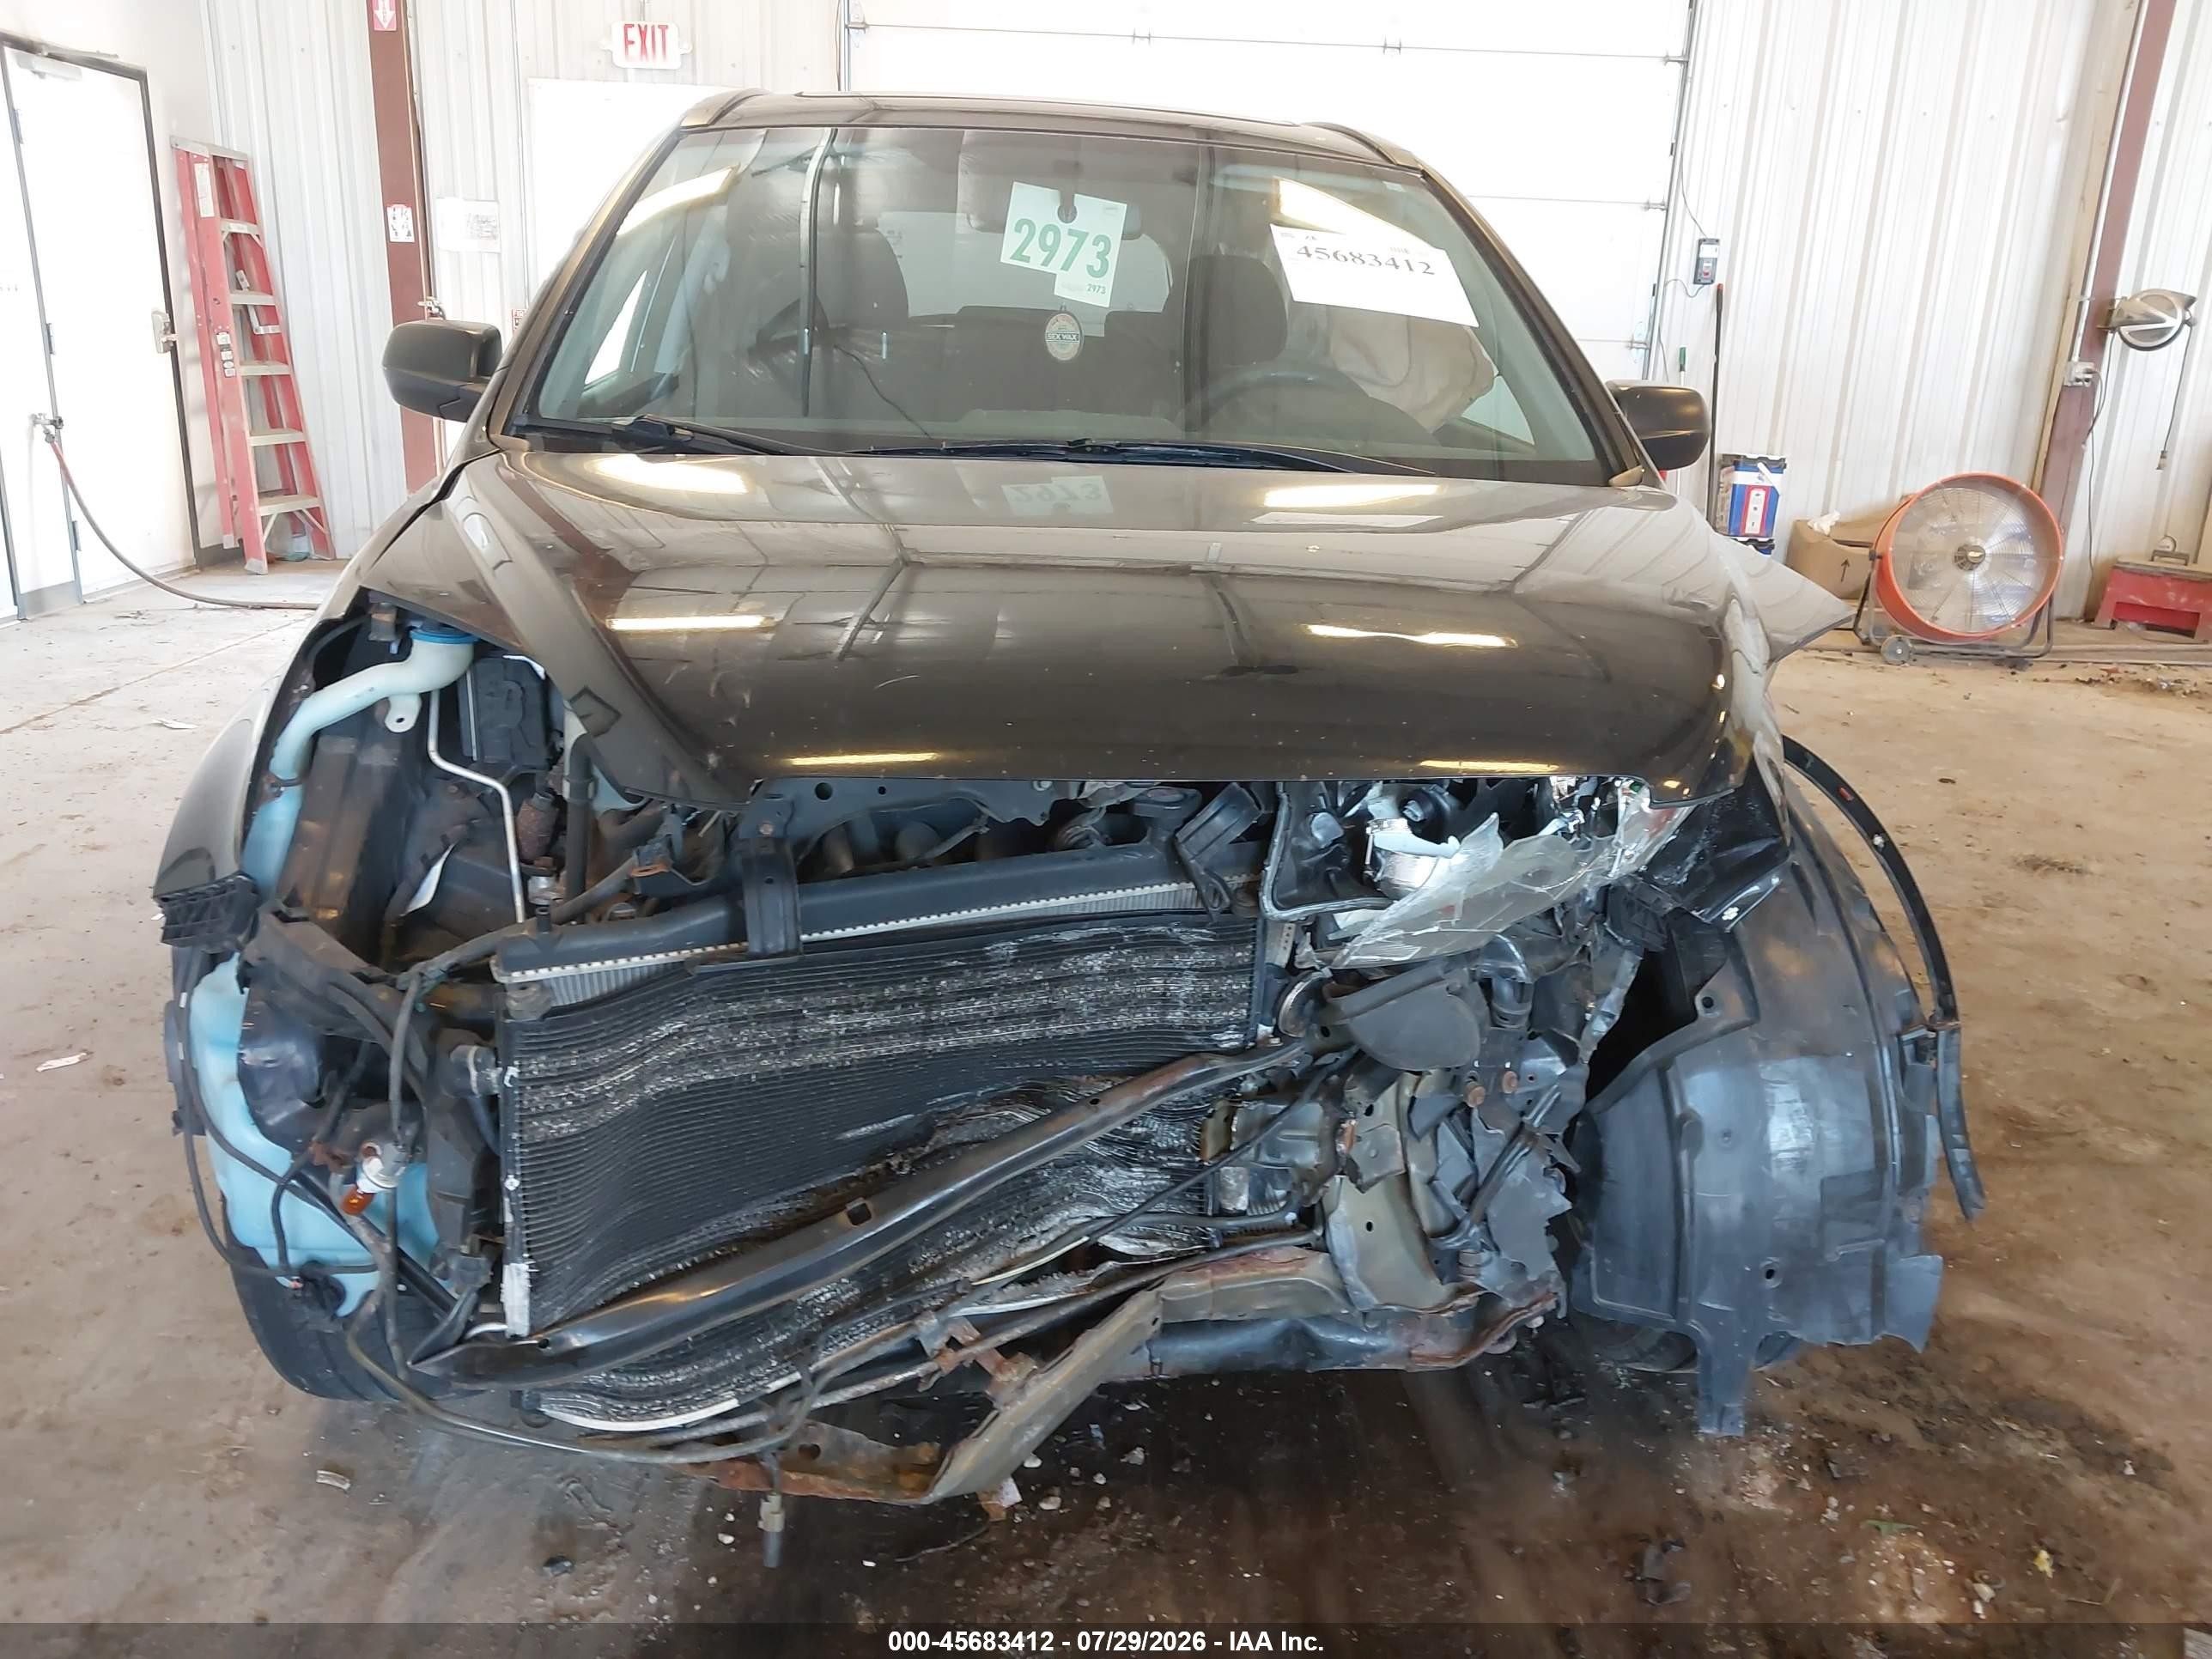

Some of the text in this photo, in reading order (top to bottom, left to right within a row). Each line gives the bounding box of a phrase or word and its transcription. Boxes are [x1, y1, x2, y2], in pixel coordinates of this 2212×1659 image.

[623, 23, 669, 62] EXIT
[1009, 218, 1112, 279] 2973
[1297, 246, 1435, 275] 45683412
[1086, 283, 1107, 295] 2973
